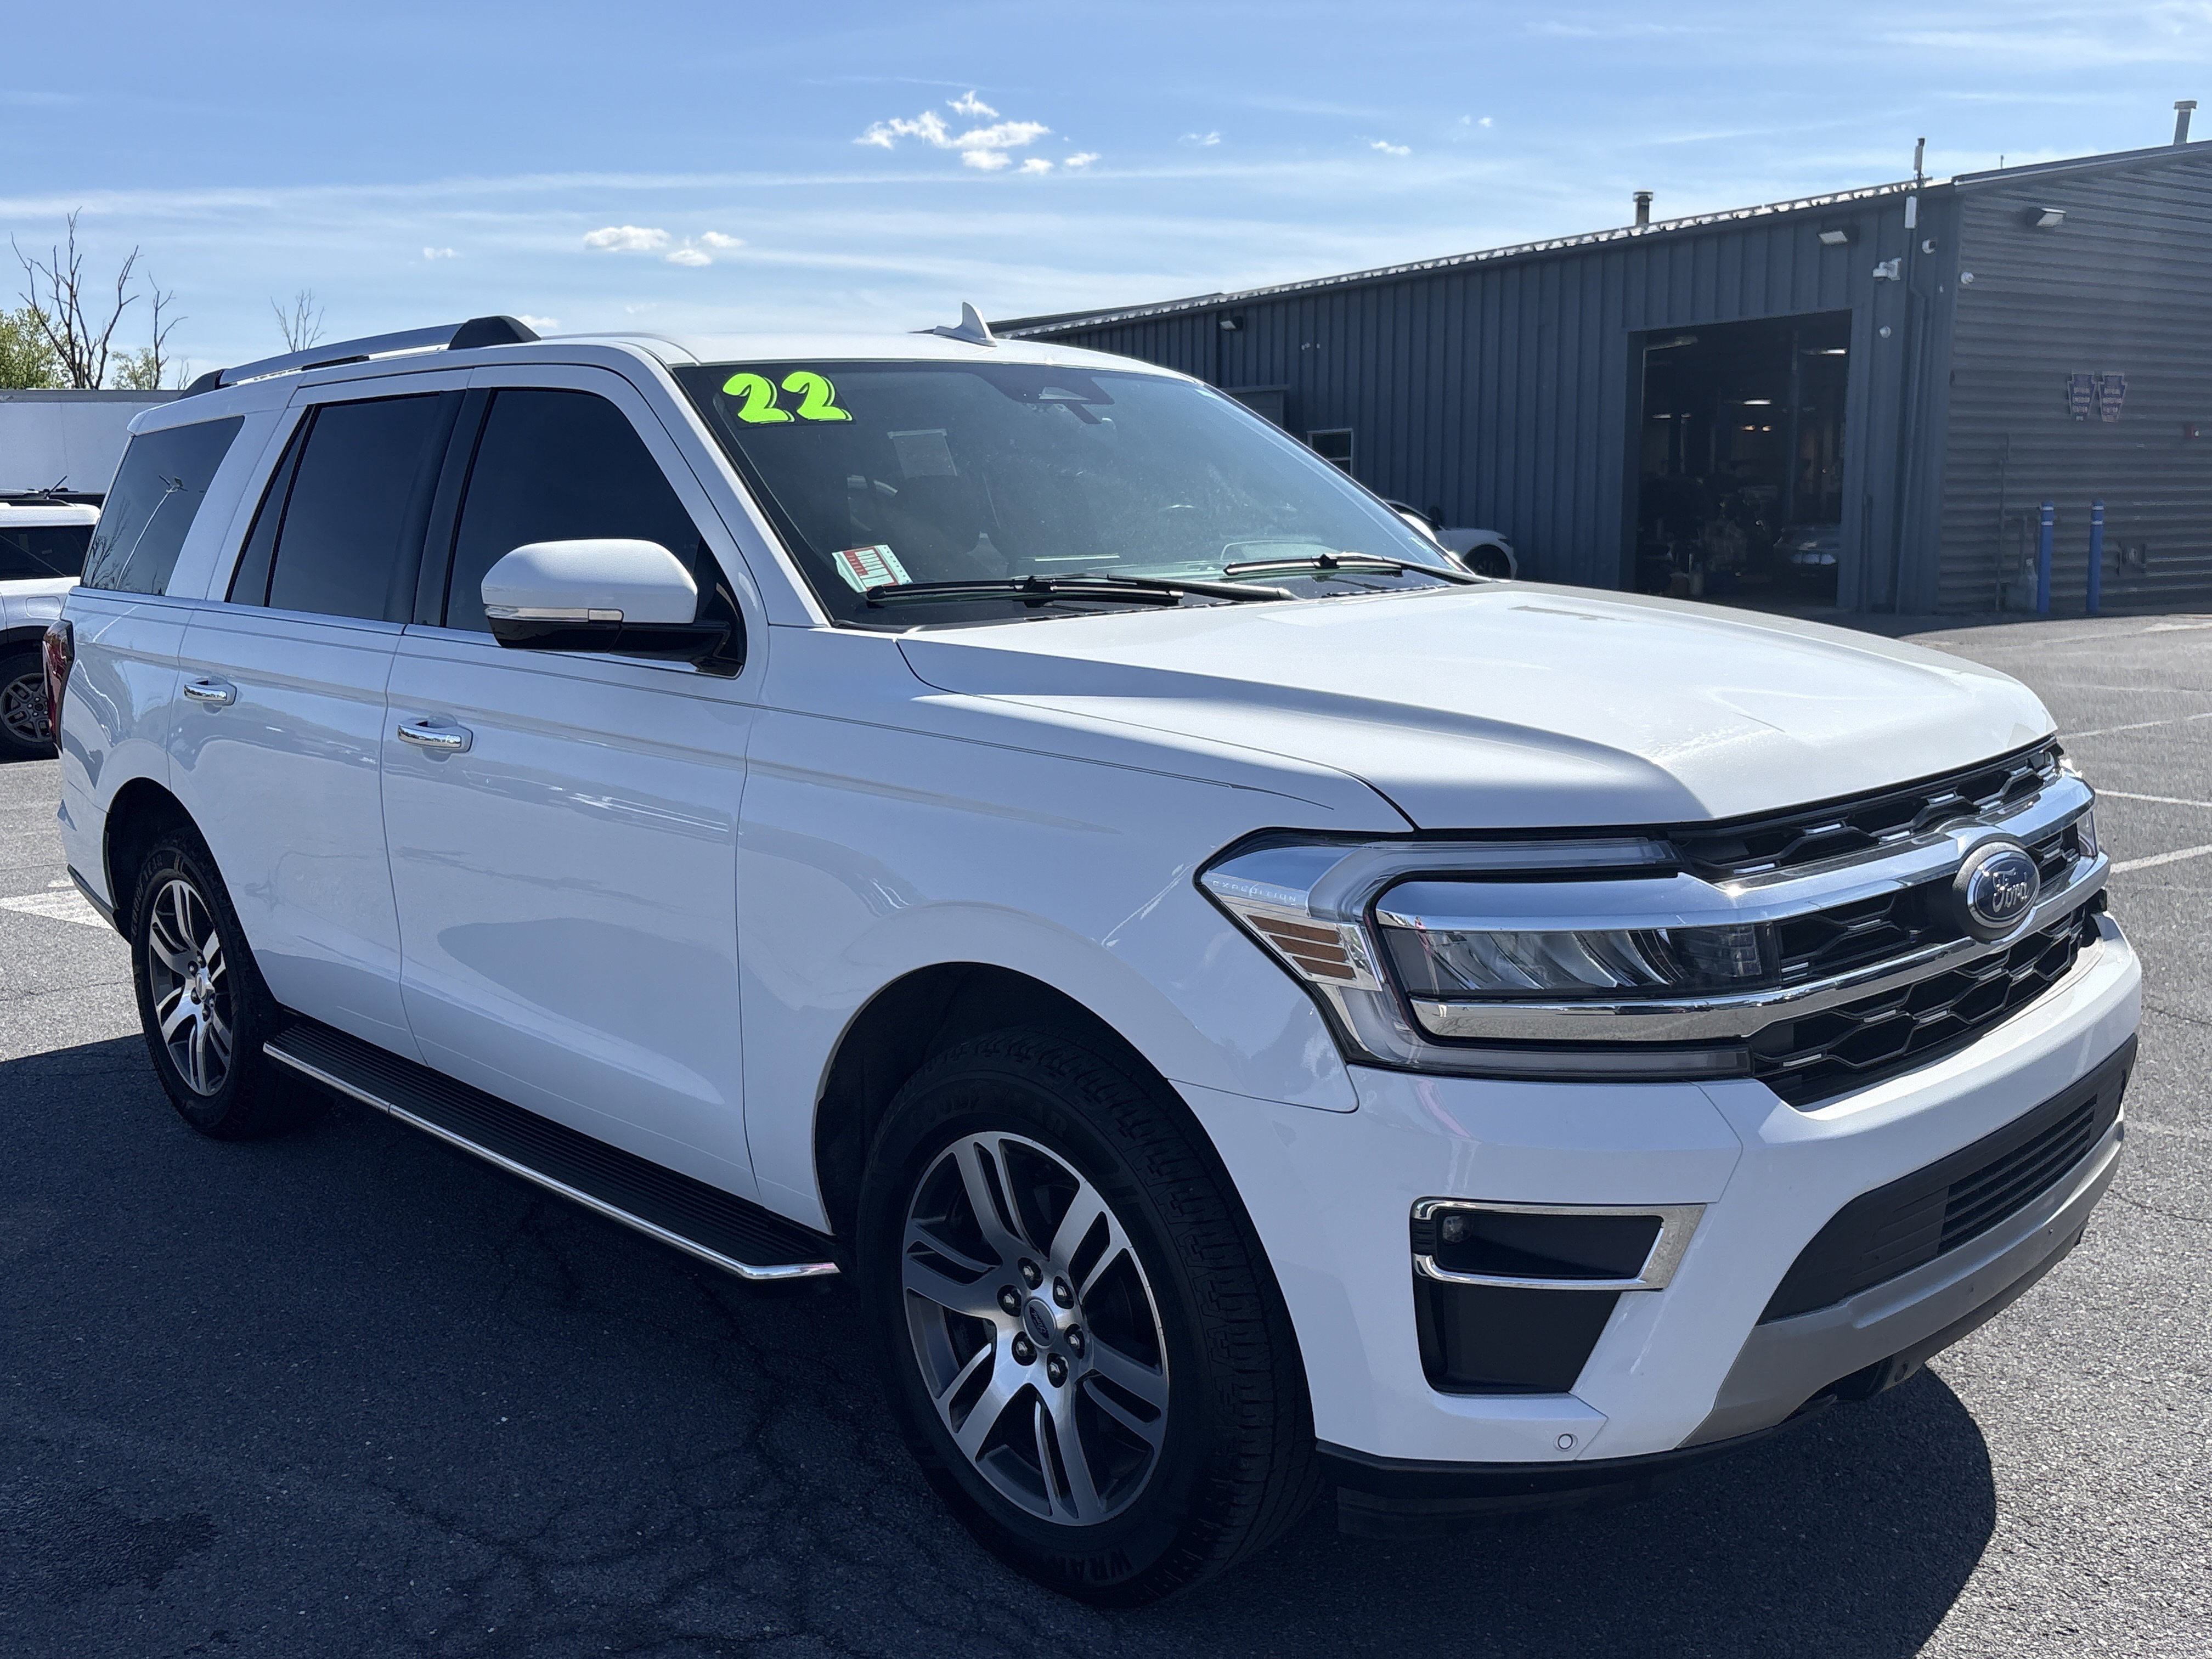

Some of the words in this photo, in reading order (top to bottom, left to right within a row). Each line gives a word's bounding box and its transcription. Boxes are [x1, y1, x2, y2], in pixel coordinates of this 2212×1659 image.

[723, 371, 853, 424] 22
[1213, 881, 1296, 902] EXPEDITION
[1993, 867, 2029, 913] Ford
